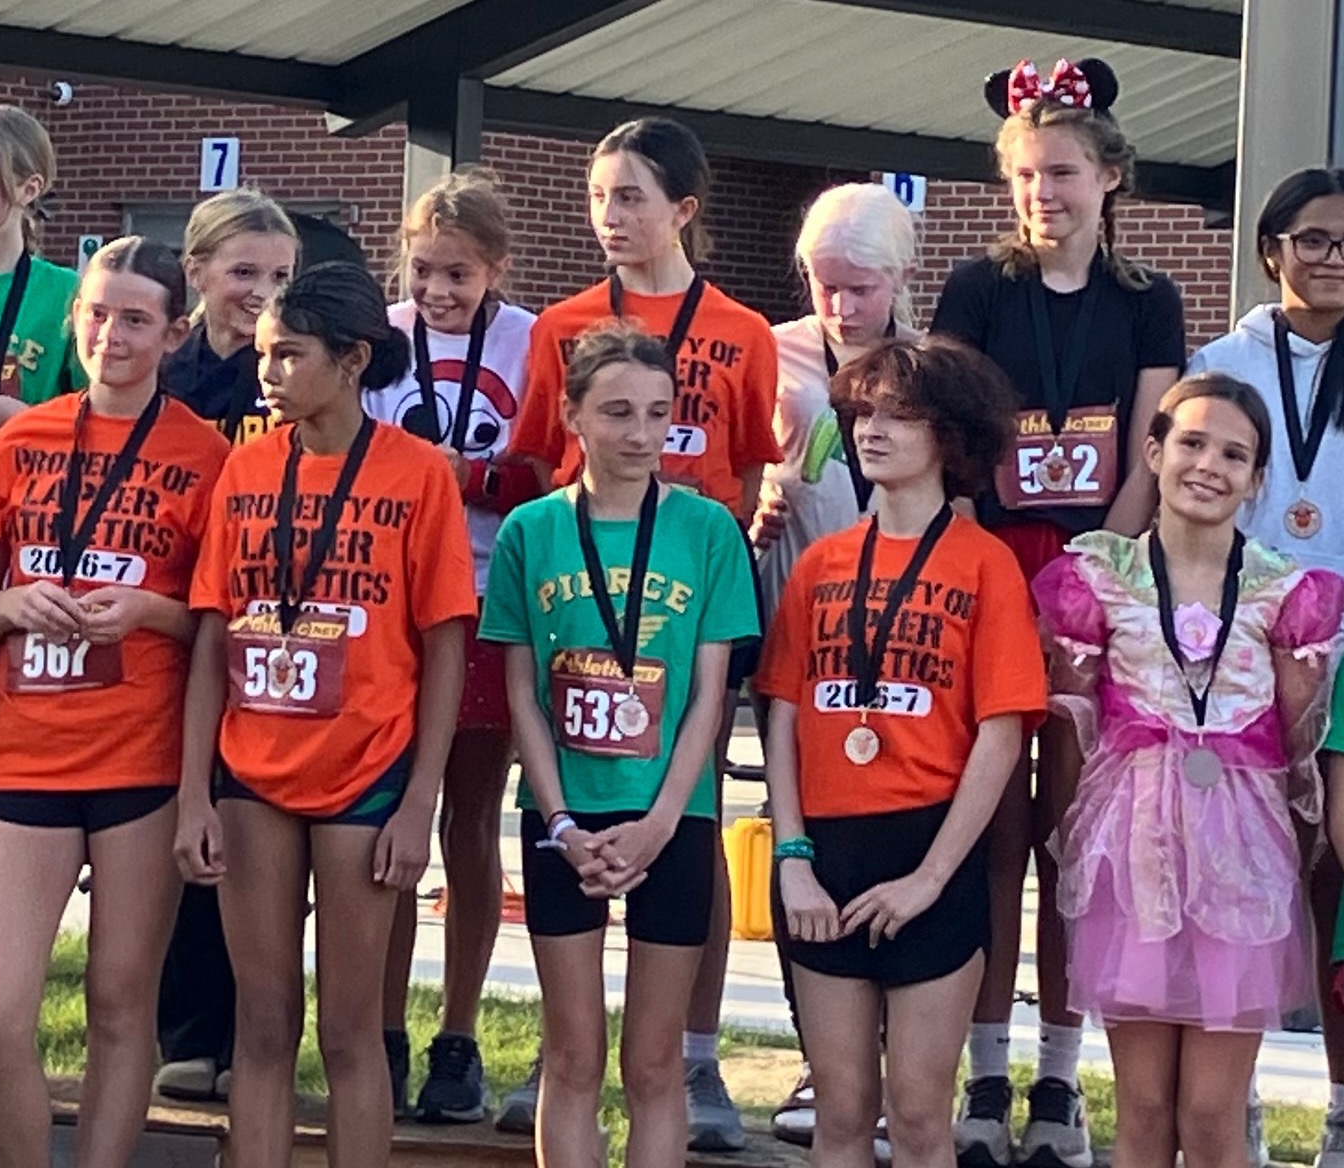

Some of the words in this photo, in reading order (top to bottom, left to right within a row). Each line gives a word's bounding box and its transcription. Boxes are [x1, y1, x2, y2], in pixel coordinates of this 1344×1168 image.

[212, 142, 230, 187] 7
[709, 340, 743, 368] OF
[14, 448, 162, 483] PROERY
[161, 464, 201, 496] OF
[1018, 444, 1100, 494] 52
[22, 479, 160, 520] LAPER
[226, 493, 371, 523] PROERY
[373, 496, 413, 529] OF
[5, 509, 175, 559] ATHTICS
[240, 528, 374, 565] LAPER
[29, 546, 134, 582] 206-7
[230, 566, 391, 605] ATHTICS
[817, 608, 945, 649] LAPER
[806, 645, 954, 690] ATHTICS
[825, 683, 919, 713] 206-7
